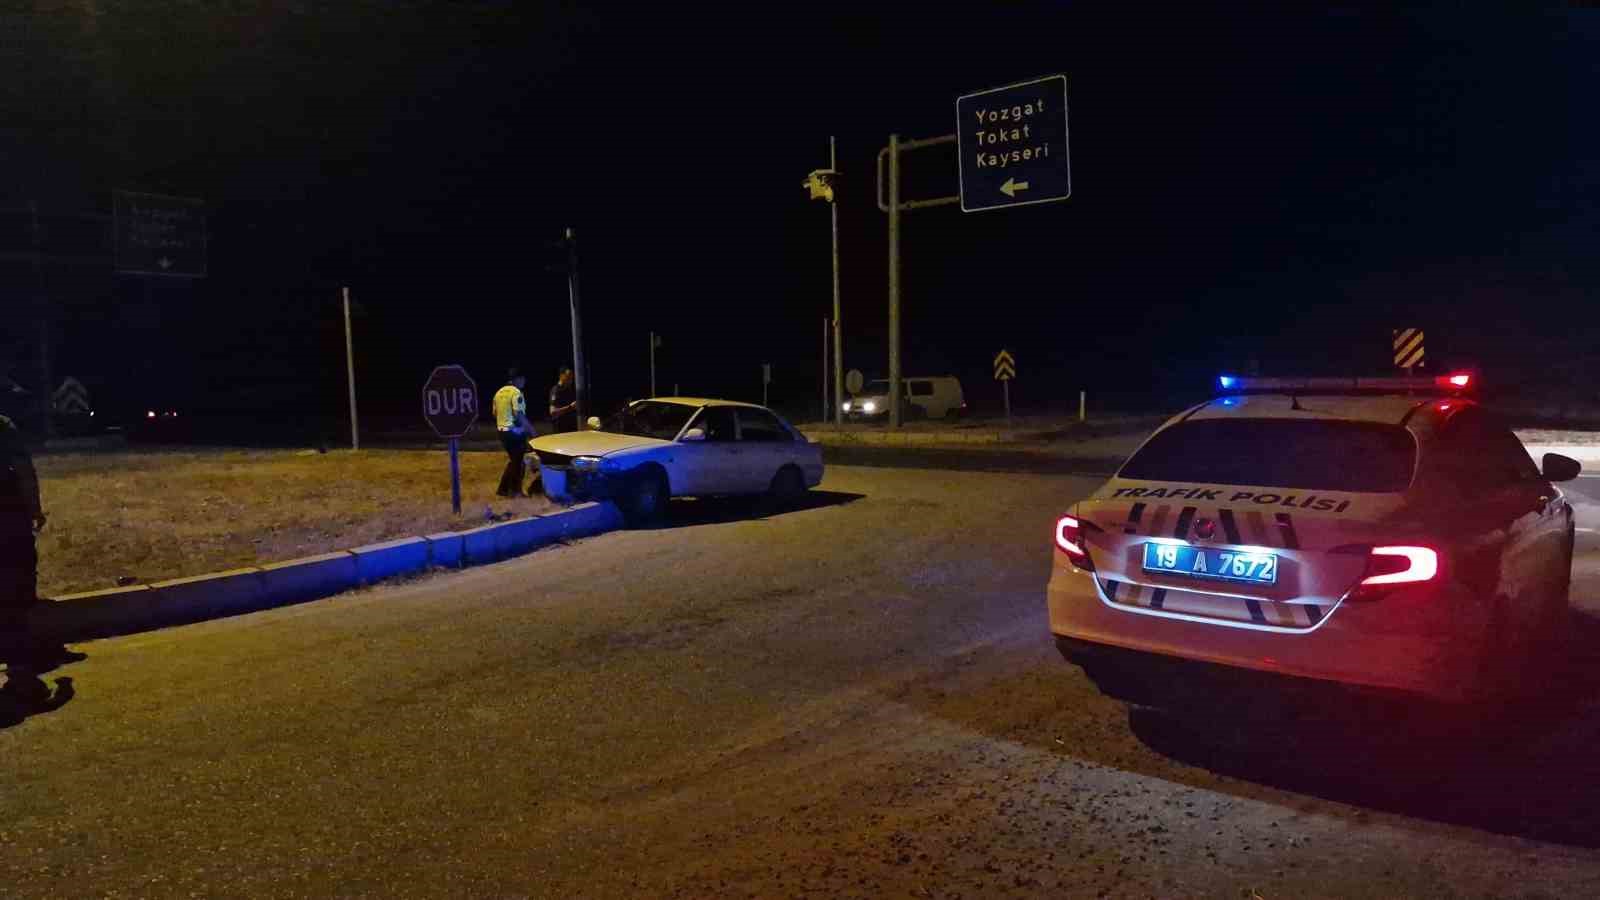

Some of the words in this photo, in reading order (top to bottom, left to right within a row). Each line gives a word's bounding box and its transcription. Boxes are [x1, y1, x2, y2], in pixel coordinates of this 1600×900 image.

[975, 99, 1045, 124] Yozgat
[975, 124, 1031, 146] Tokat
[976, 143, 1049, 168] Kayseri
[428, 388, 474, 416] DUR
[1156, 544, 1177, 568] 19
[1193, 551, 1207, 572] A
[1218, 553, 1274, 579] 7672
